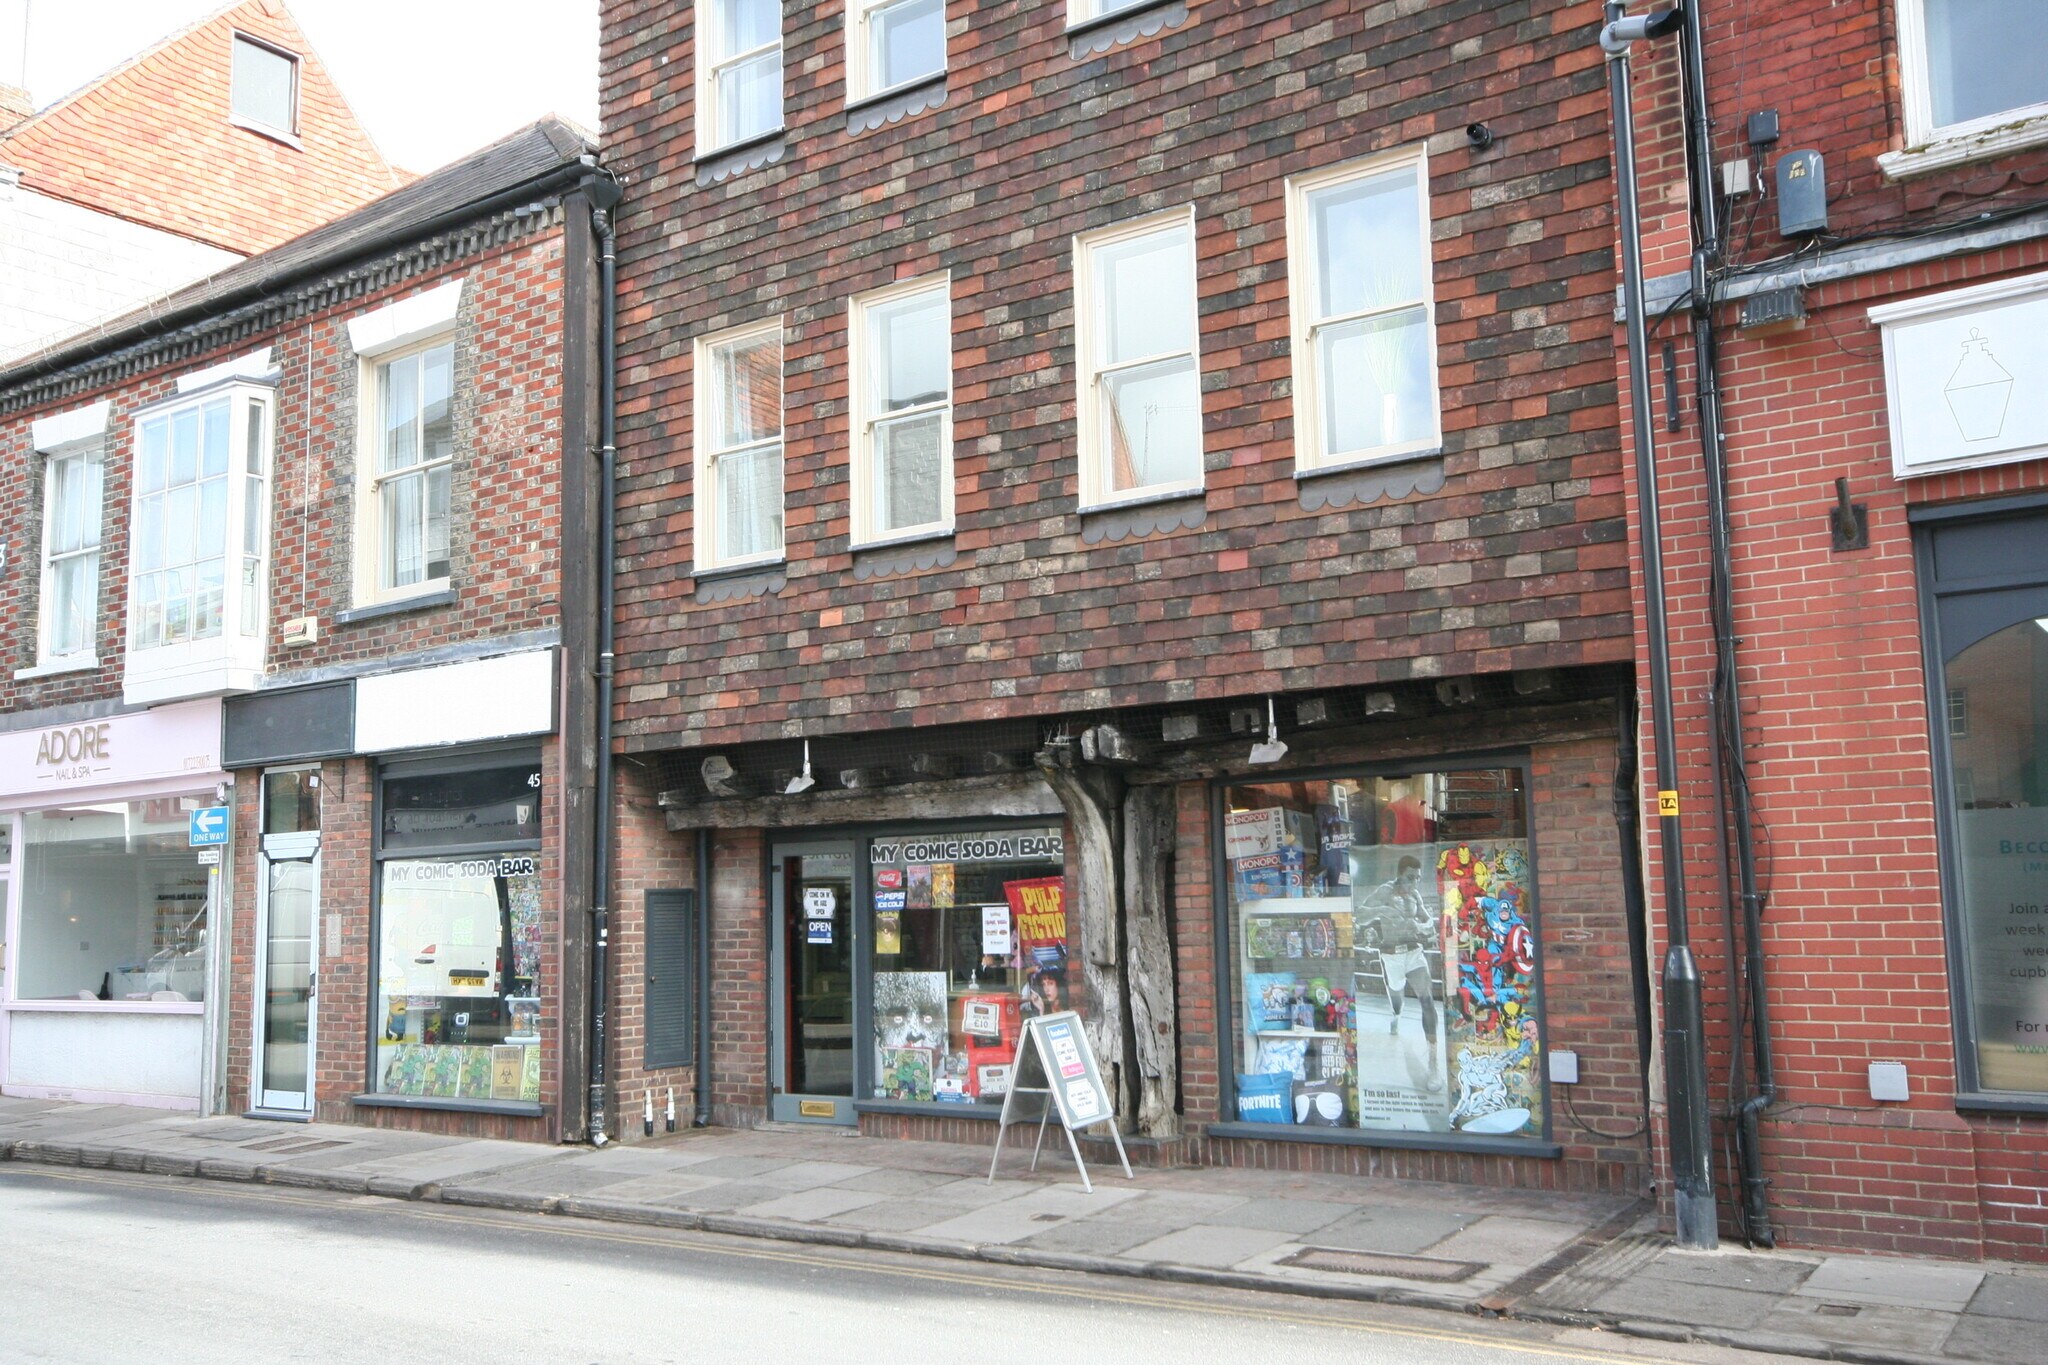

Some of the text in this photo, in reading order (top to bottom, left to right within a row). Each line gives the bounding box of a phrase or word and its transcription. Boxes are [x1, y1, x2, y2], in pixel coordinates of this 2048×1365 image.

[36, 723, 110, 765] ADORE
[56, 766, 91, 780] NAIL & SPA
[528, 773, 540, 787] 45
[1661, 798, 1676, 808] 1A
[1225, 812, 1268, 825] MONOPOLY
[194, 832, 225, 842] ONE WAY
[871, 844, 900, 863] MY
[903, 840, 958, 862] COMIC
[961, 839, 1013, 860] SODA
[1018, 836, 1063, 856] BAR
[391, 858, 533, 881] MY COMIC SODA BAR
[884, 892, 906, 900] PEPSI
[1020, 886, 1060, 914] PULP
[2009, 903, 2038, 914] Join
[809, 922, 831, 931] OPEN
[2005, 924, 2046, 936] week
[973, 1020, 989, 1028] £10
[2016, 1021, 2040, 1032] For
[1239, 1094, 1281, 1111] FORTNITE
